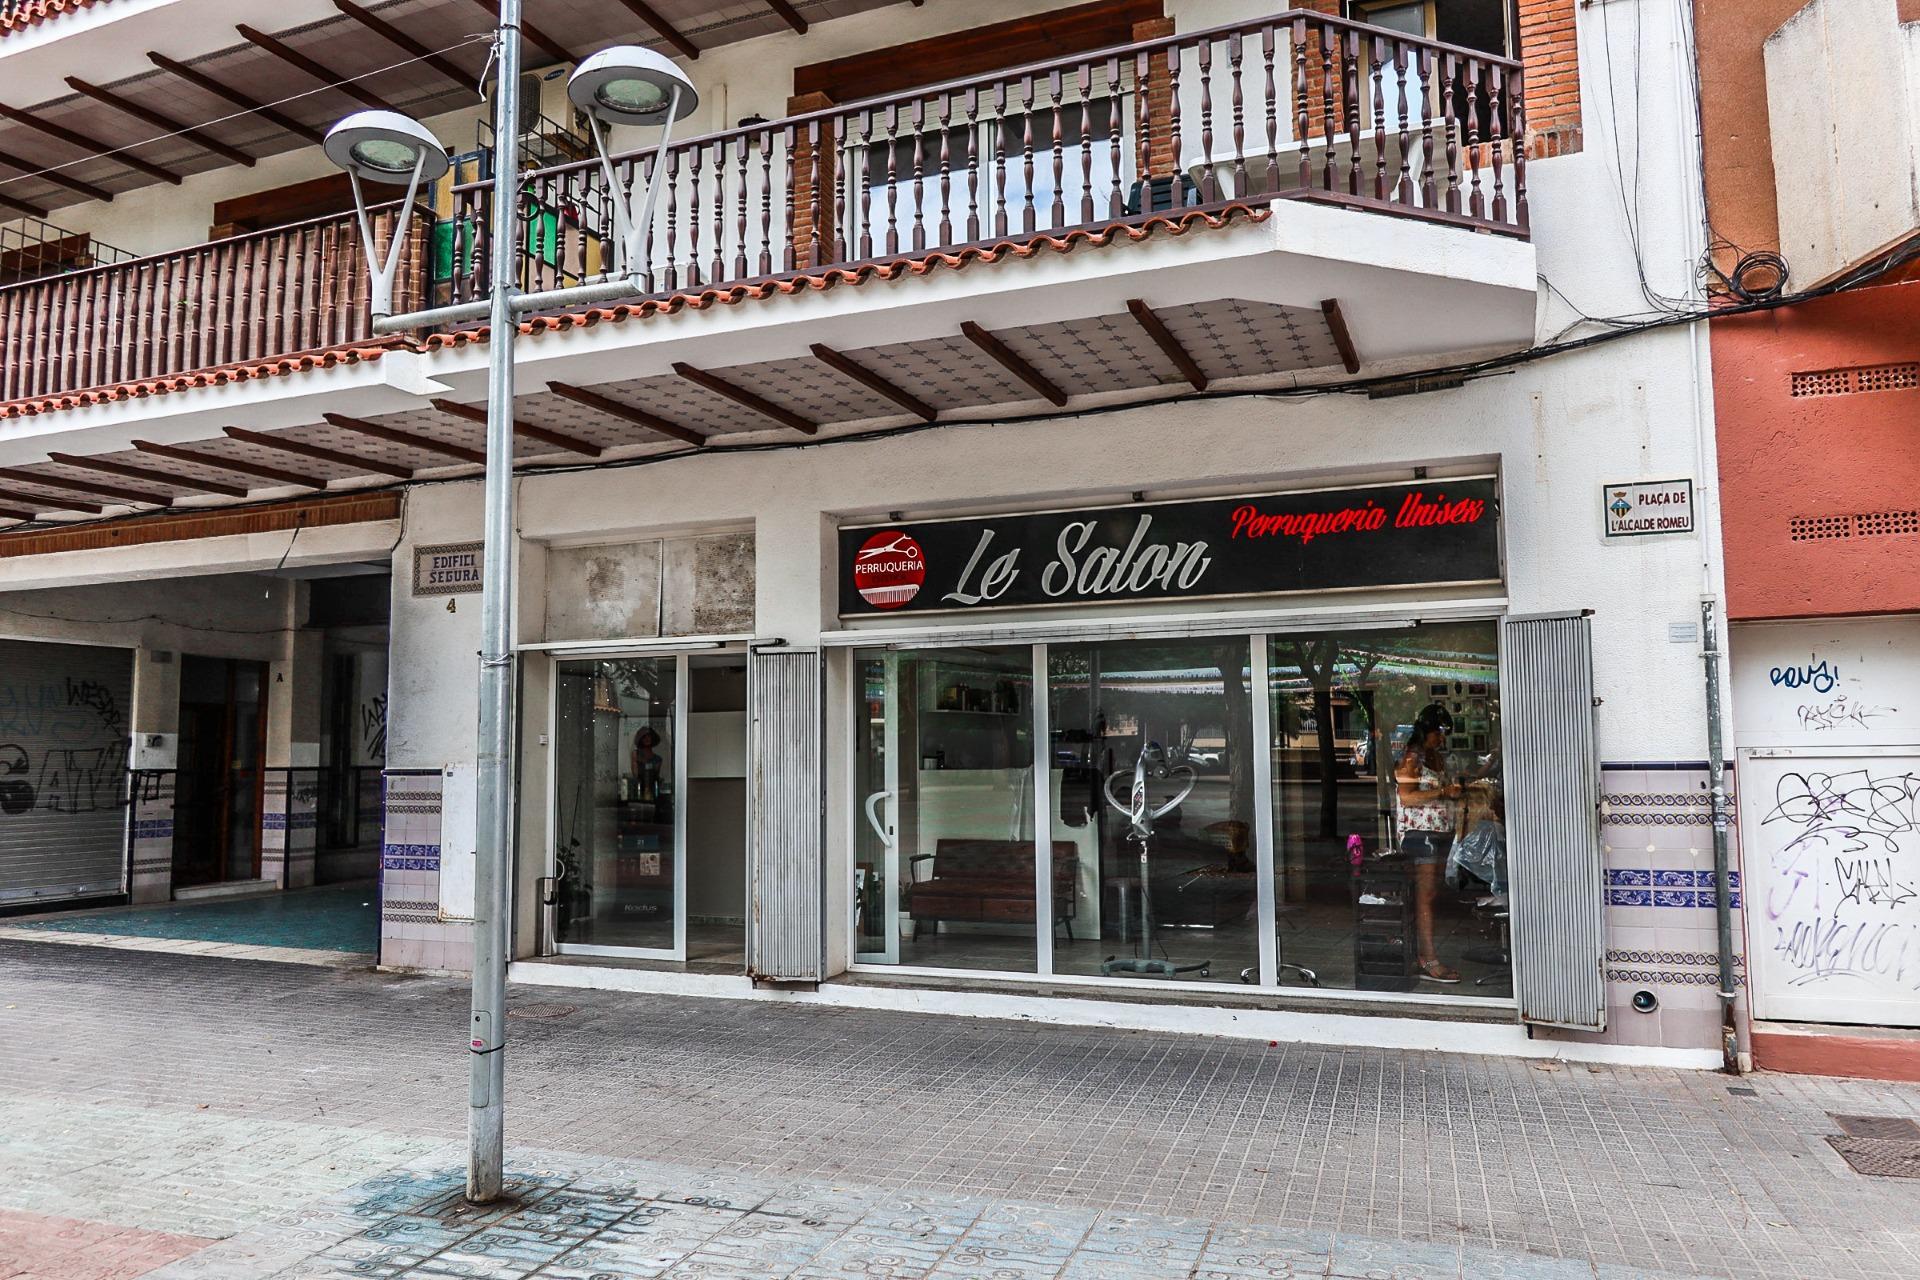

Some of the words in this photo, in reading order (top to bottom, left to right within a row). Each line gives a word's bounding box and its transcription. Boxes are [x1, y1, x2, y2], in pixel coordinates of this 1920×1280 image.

[1638, 492, 1670, 506] PLAÇA
[1673, 491, 1686, 504] DE
[1231, 500, 1388, 545] Perruqueria
[1395, 492, 1485, 529] Unisex
[1611, 518, 1655, 532] L'ALCALDE
[1657, 516, 1689, 530] ROMEU
[433, 554, 475, 569] EDIFICI
[854, 560, 924, 575] PERRUQUERIA
[941, 529, 1021, 605] Le
[1041, 514, 1212, 597] Salon
[429, 568, 480, 584] SEGURA
[446, 597, 456, 614] 4
